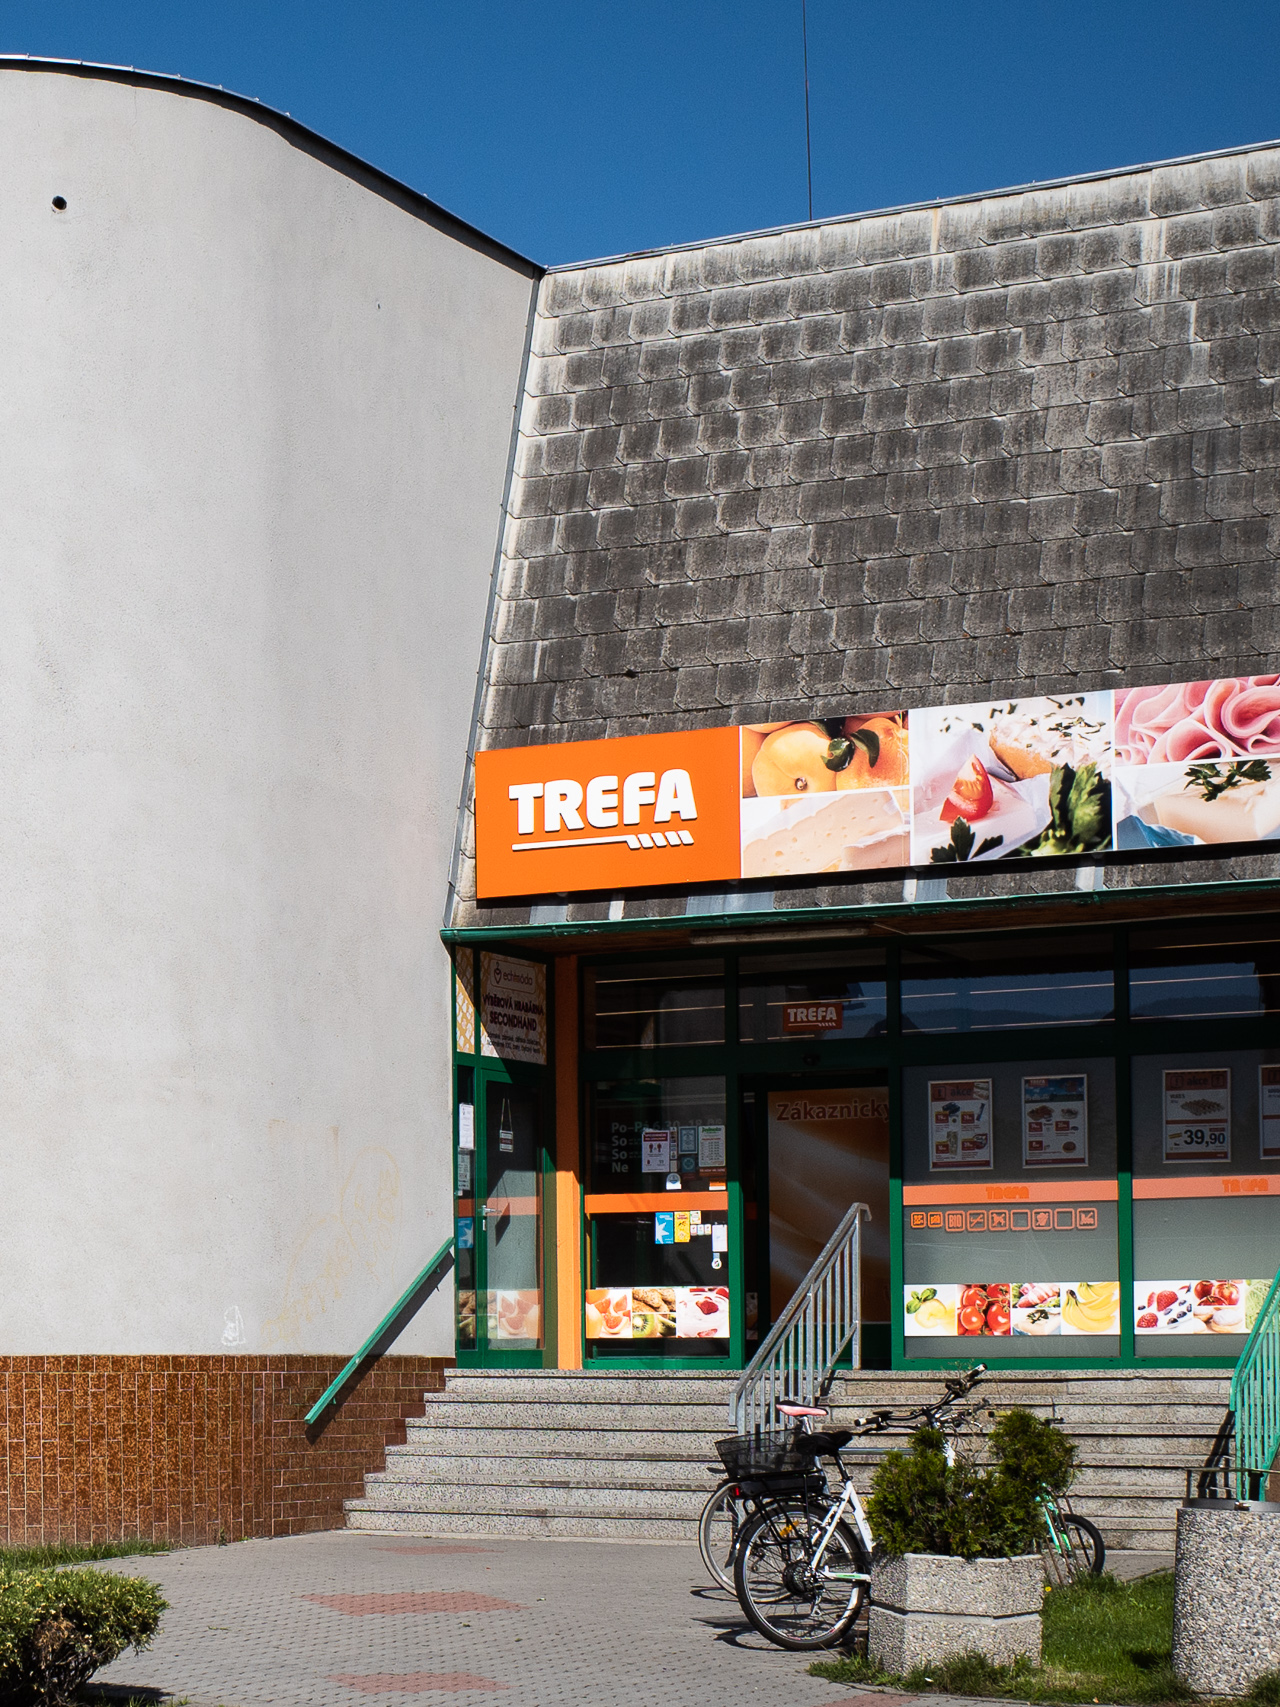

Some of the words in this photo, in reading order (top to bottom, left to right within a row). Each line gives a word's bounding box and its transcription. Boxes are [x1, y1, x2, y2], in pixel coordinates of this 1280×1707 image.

[508, 768, 697, 835] TREFA
[490, 1011, 537, 1031] SECONDHAND
[787, 1007, 837, 1022] TREFA
[611, 1135, 628, 1147] So
[1184, 1129, 1226, 1147] 39,90
[611, 1149, 628, 1160] So
[611, 1162, 629, 1173] Ne
[949, 1214, 962, 1227] BIO
